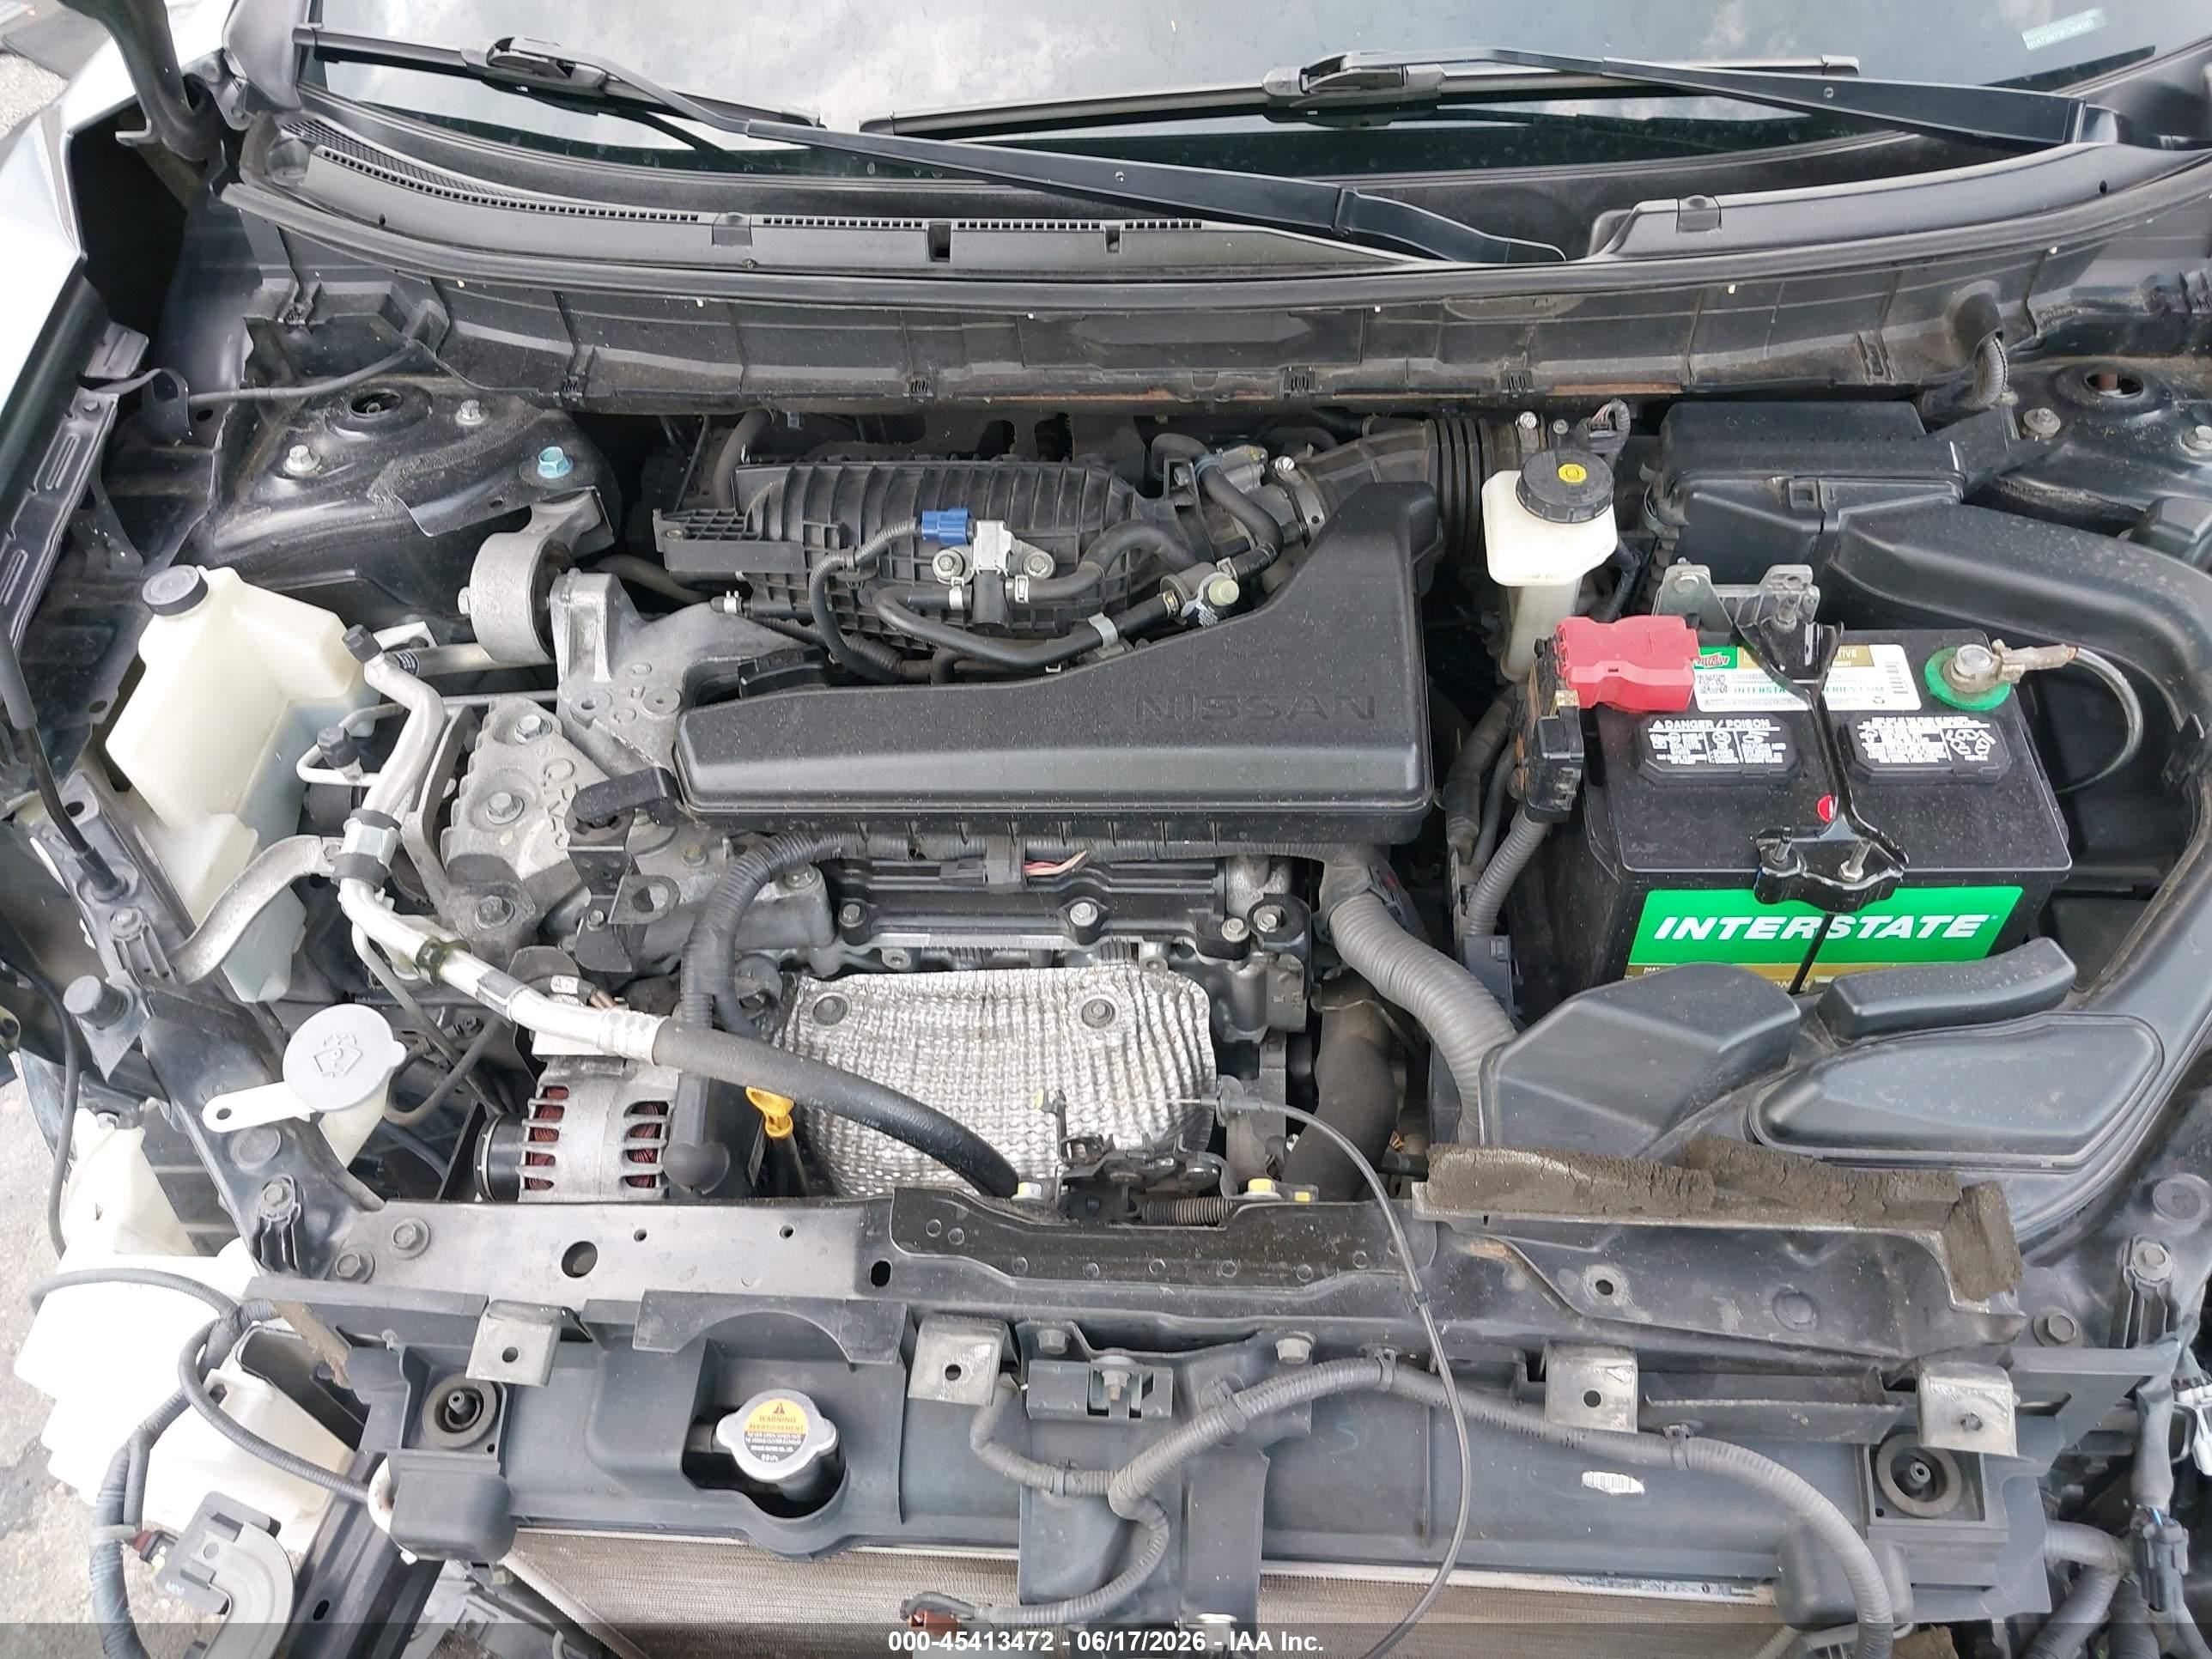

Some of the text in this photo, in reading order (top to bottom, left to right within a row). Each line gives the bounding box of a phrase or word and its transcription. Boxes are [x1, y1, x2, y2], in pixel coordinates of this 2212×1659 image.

[1134, 692, 1374, 720] NISSAN
[1664, 719, 1714, 730] DANGER
[1725, 719, 1771, 729] POISON
[1654, 915, 1990, 940] INTERSTATE
